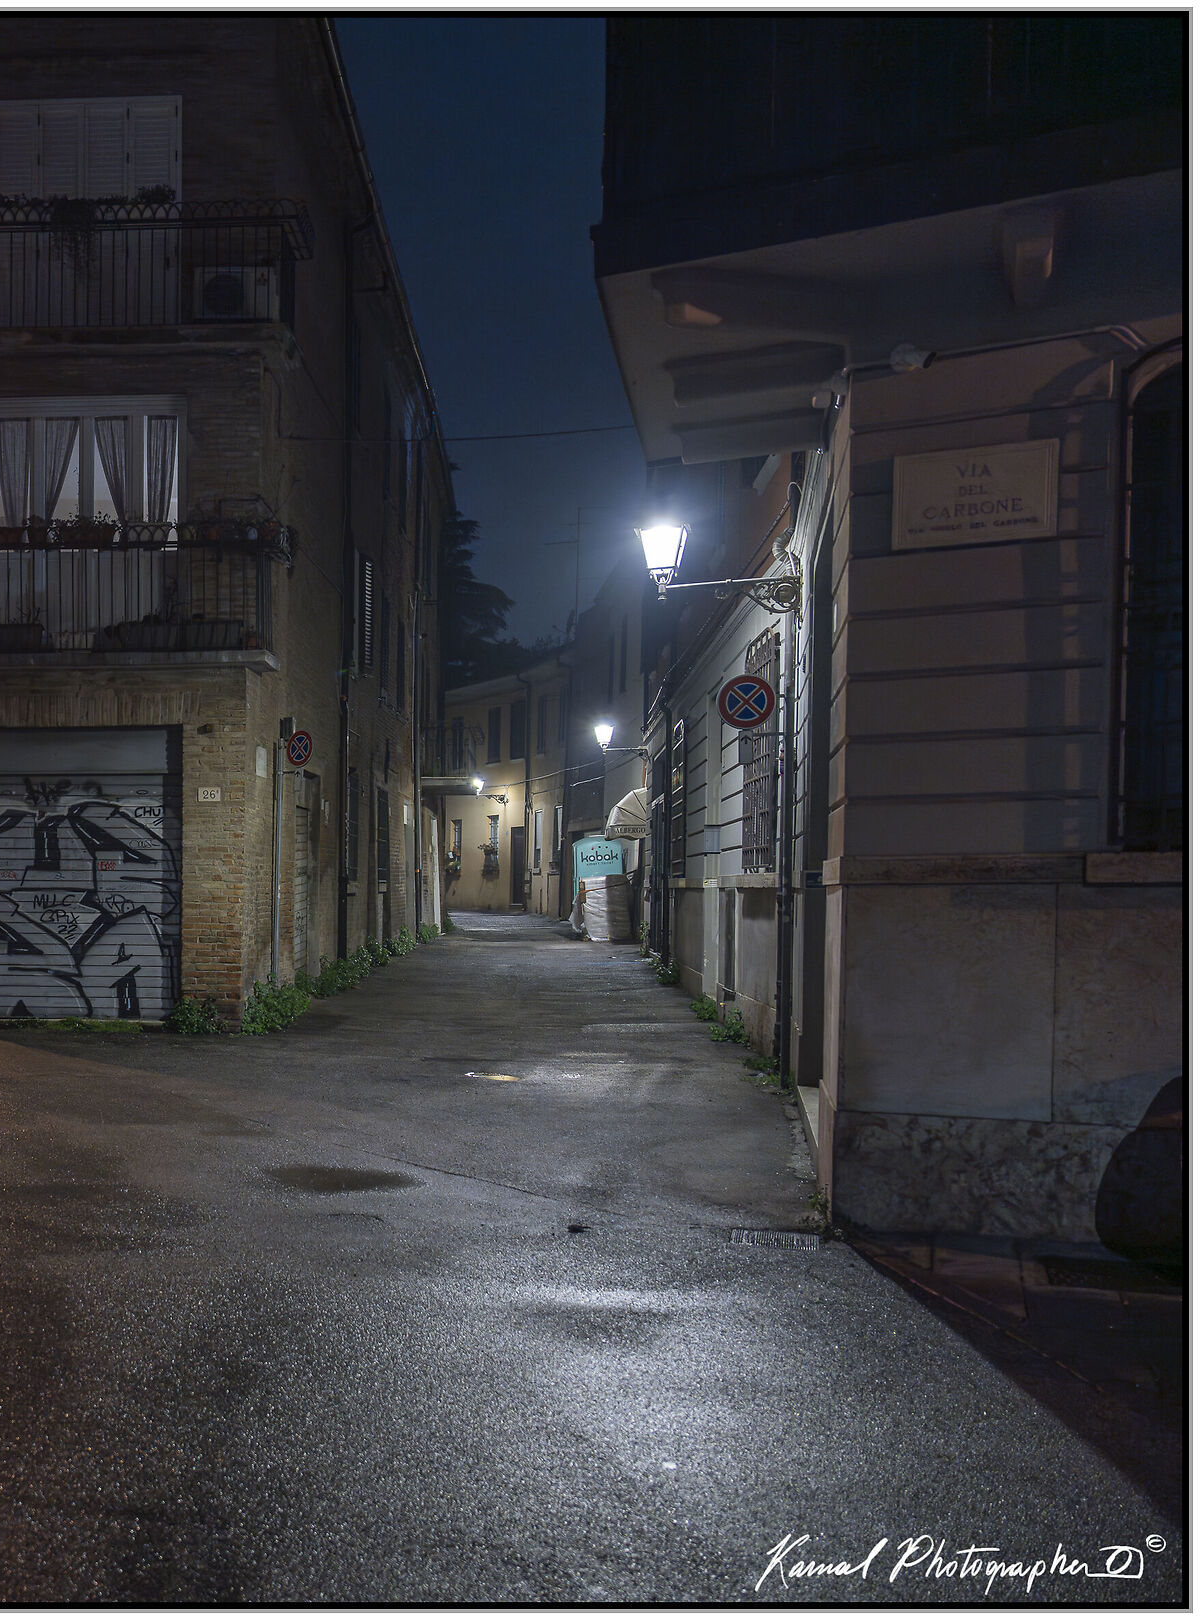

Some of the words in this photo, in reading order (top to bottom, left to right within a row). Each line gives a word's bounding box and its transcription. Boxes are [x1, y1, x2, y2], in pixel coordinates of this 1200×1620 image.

[956, 463, 993, 478] VIA
[958, 485, 988, 497] DEL
[922, 497, 1025, 520] CARBONE
[581, 850, 618, 862] kobak
[57, 924, 78, 934] 22
